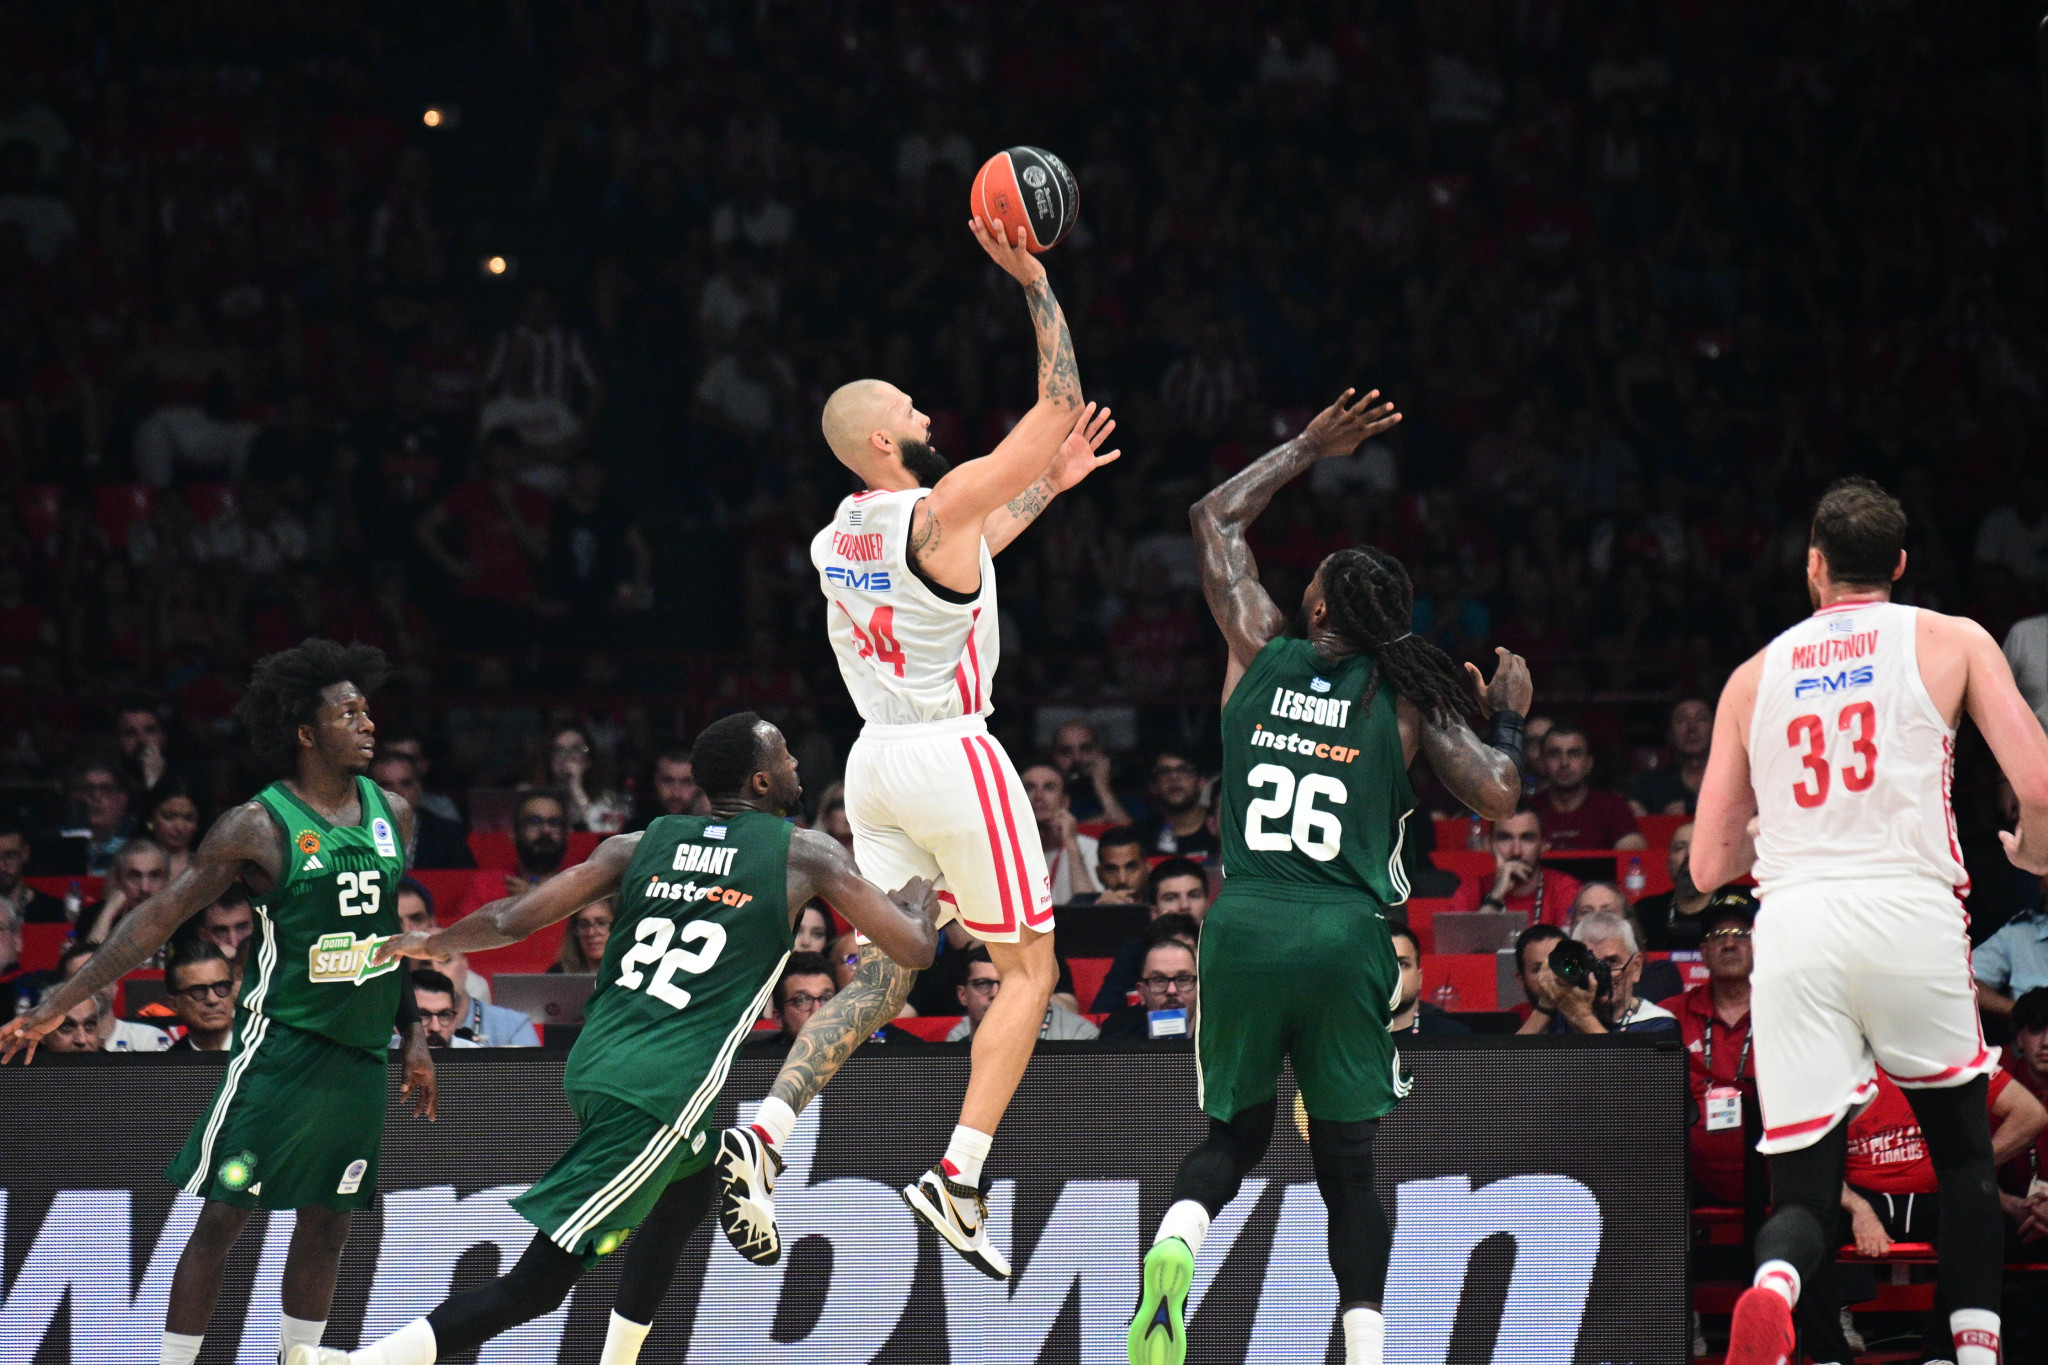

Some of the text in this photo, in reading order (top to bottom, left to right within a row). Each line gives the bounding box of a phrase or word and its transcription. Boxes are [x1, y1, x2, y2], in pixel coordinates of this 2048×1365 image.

[1795, 665, 1874, 699] FMS
[1270, 687, 1351, 728] LESSORT
[1251, 723, 1360, 763] instacar
[1787, 700, 1878, 809] 33
[1245, 763, 1348, 861] 26
[672, 843, 738, 876] GRANT
[336, 870, 381, 917] 25
[645, 875, 753, 909] instacar
[615, 917, 727, 1010] 22
[686, 1091, 1604, 1365] bwin
